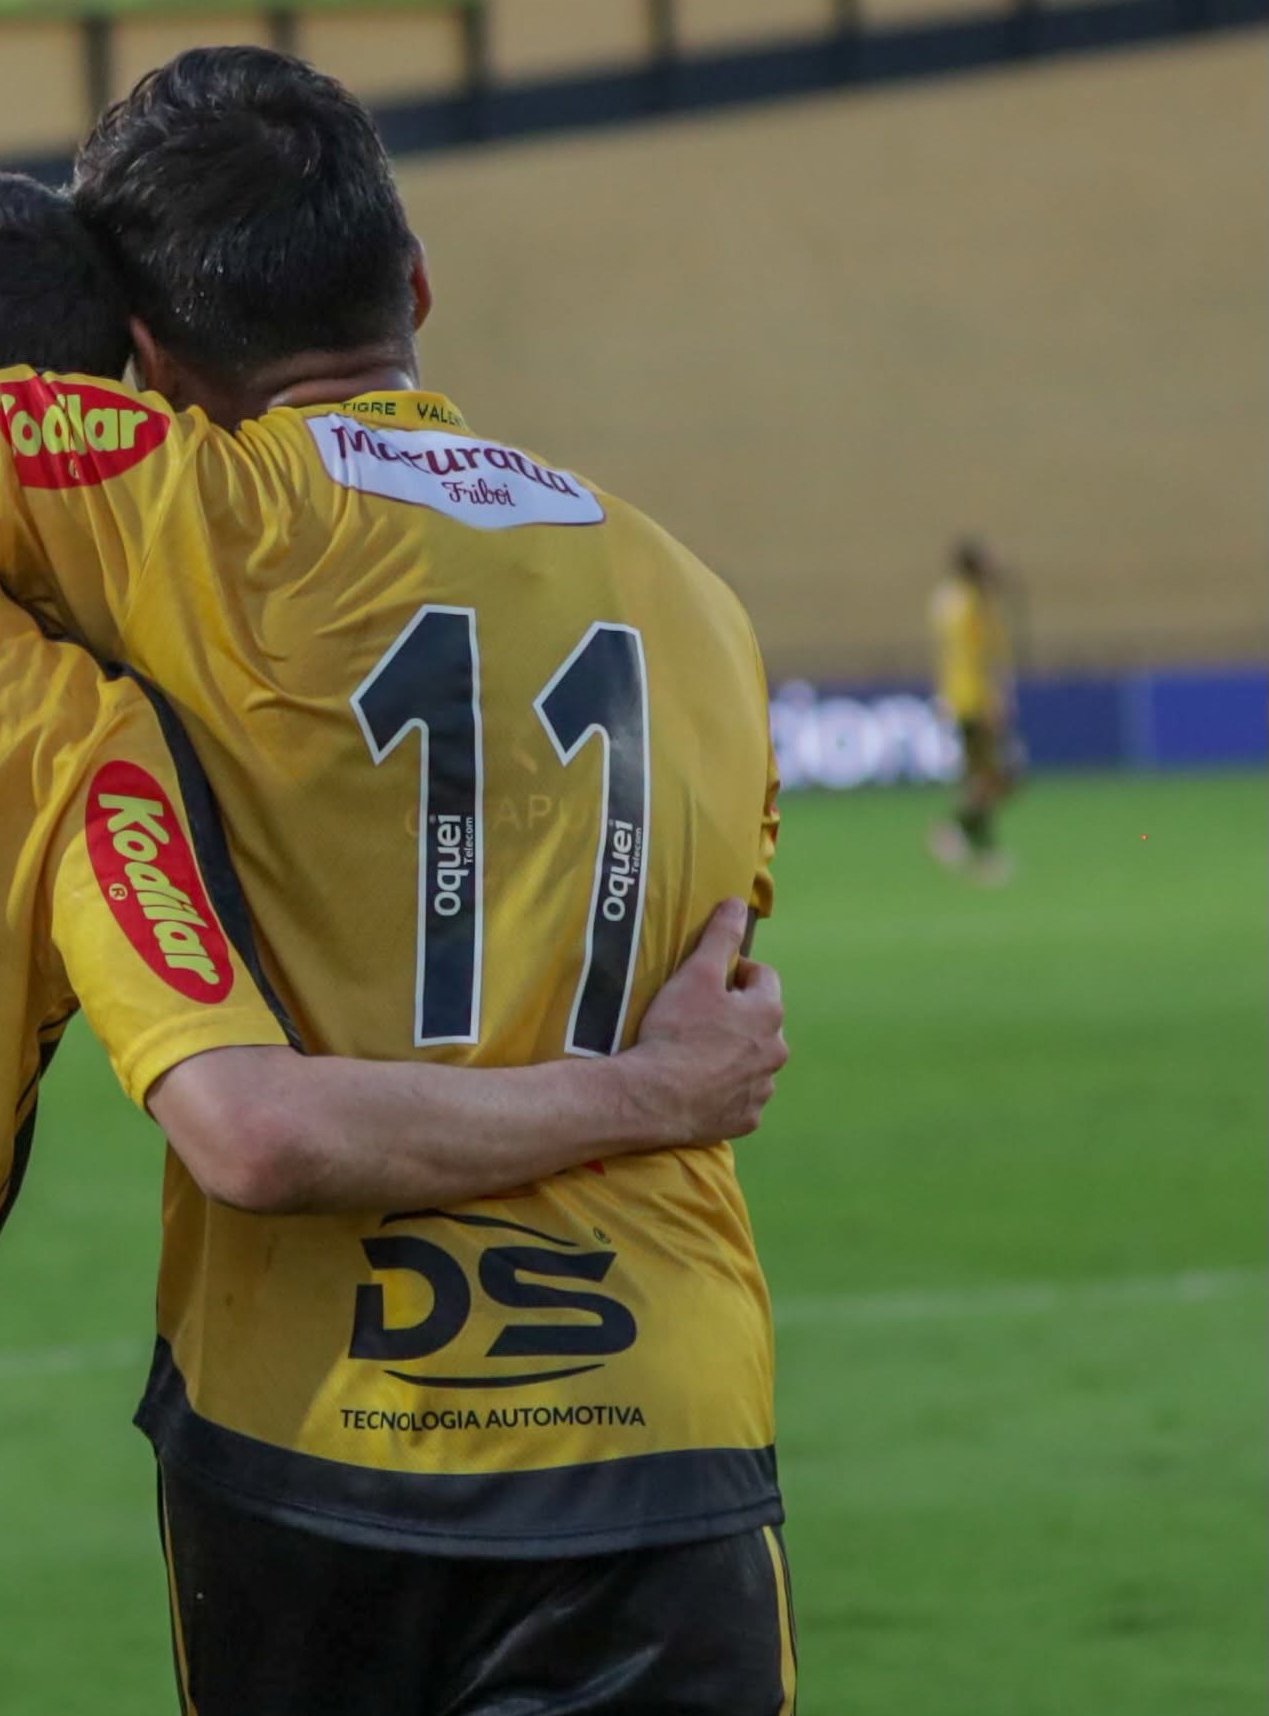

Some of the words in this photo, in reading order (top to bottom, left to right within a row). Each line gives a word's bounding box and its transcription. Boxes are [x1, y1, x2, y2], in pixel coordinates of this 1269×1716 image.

[341, 402, 396, 416] TIGRE
[441, 477, 516, 507] Friboi
[349, 604, 650, 1058] 11
[463, 817, 474, 865] Telecom
[631, 827, 642, 873] Telecom
[98, 793, 220, 984] Kodilar
[347, 1235, 638, 1361] DS
[340, 1408, 482, 1432] TECNOLOGIA
[485, 1405, 646, 1428] AUTOMOTIVA
